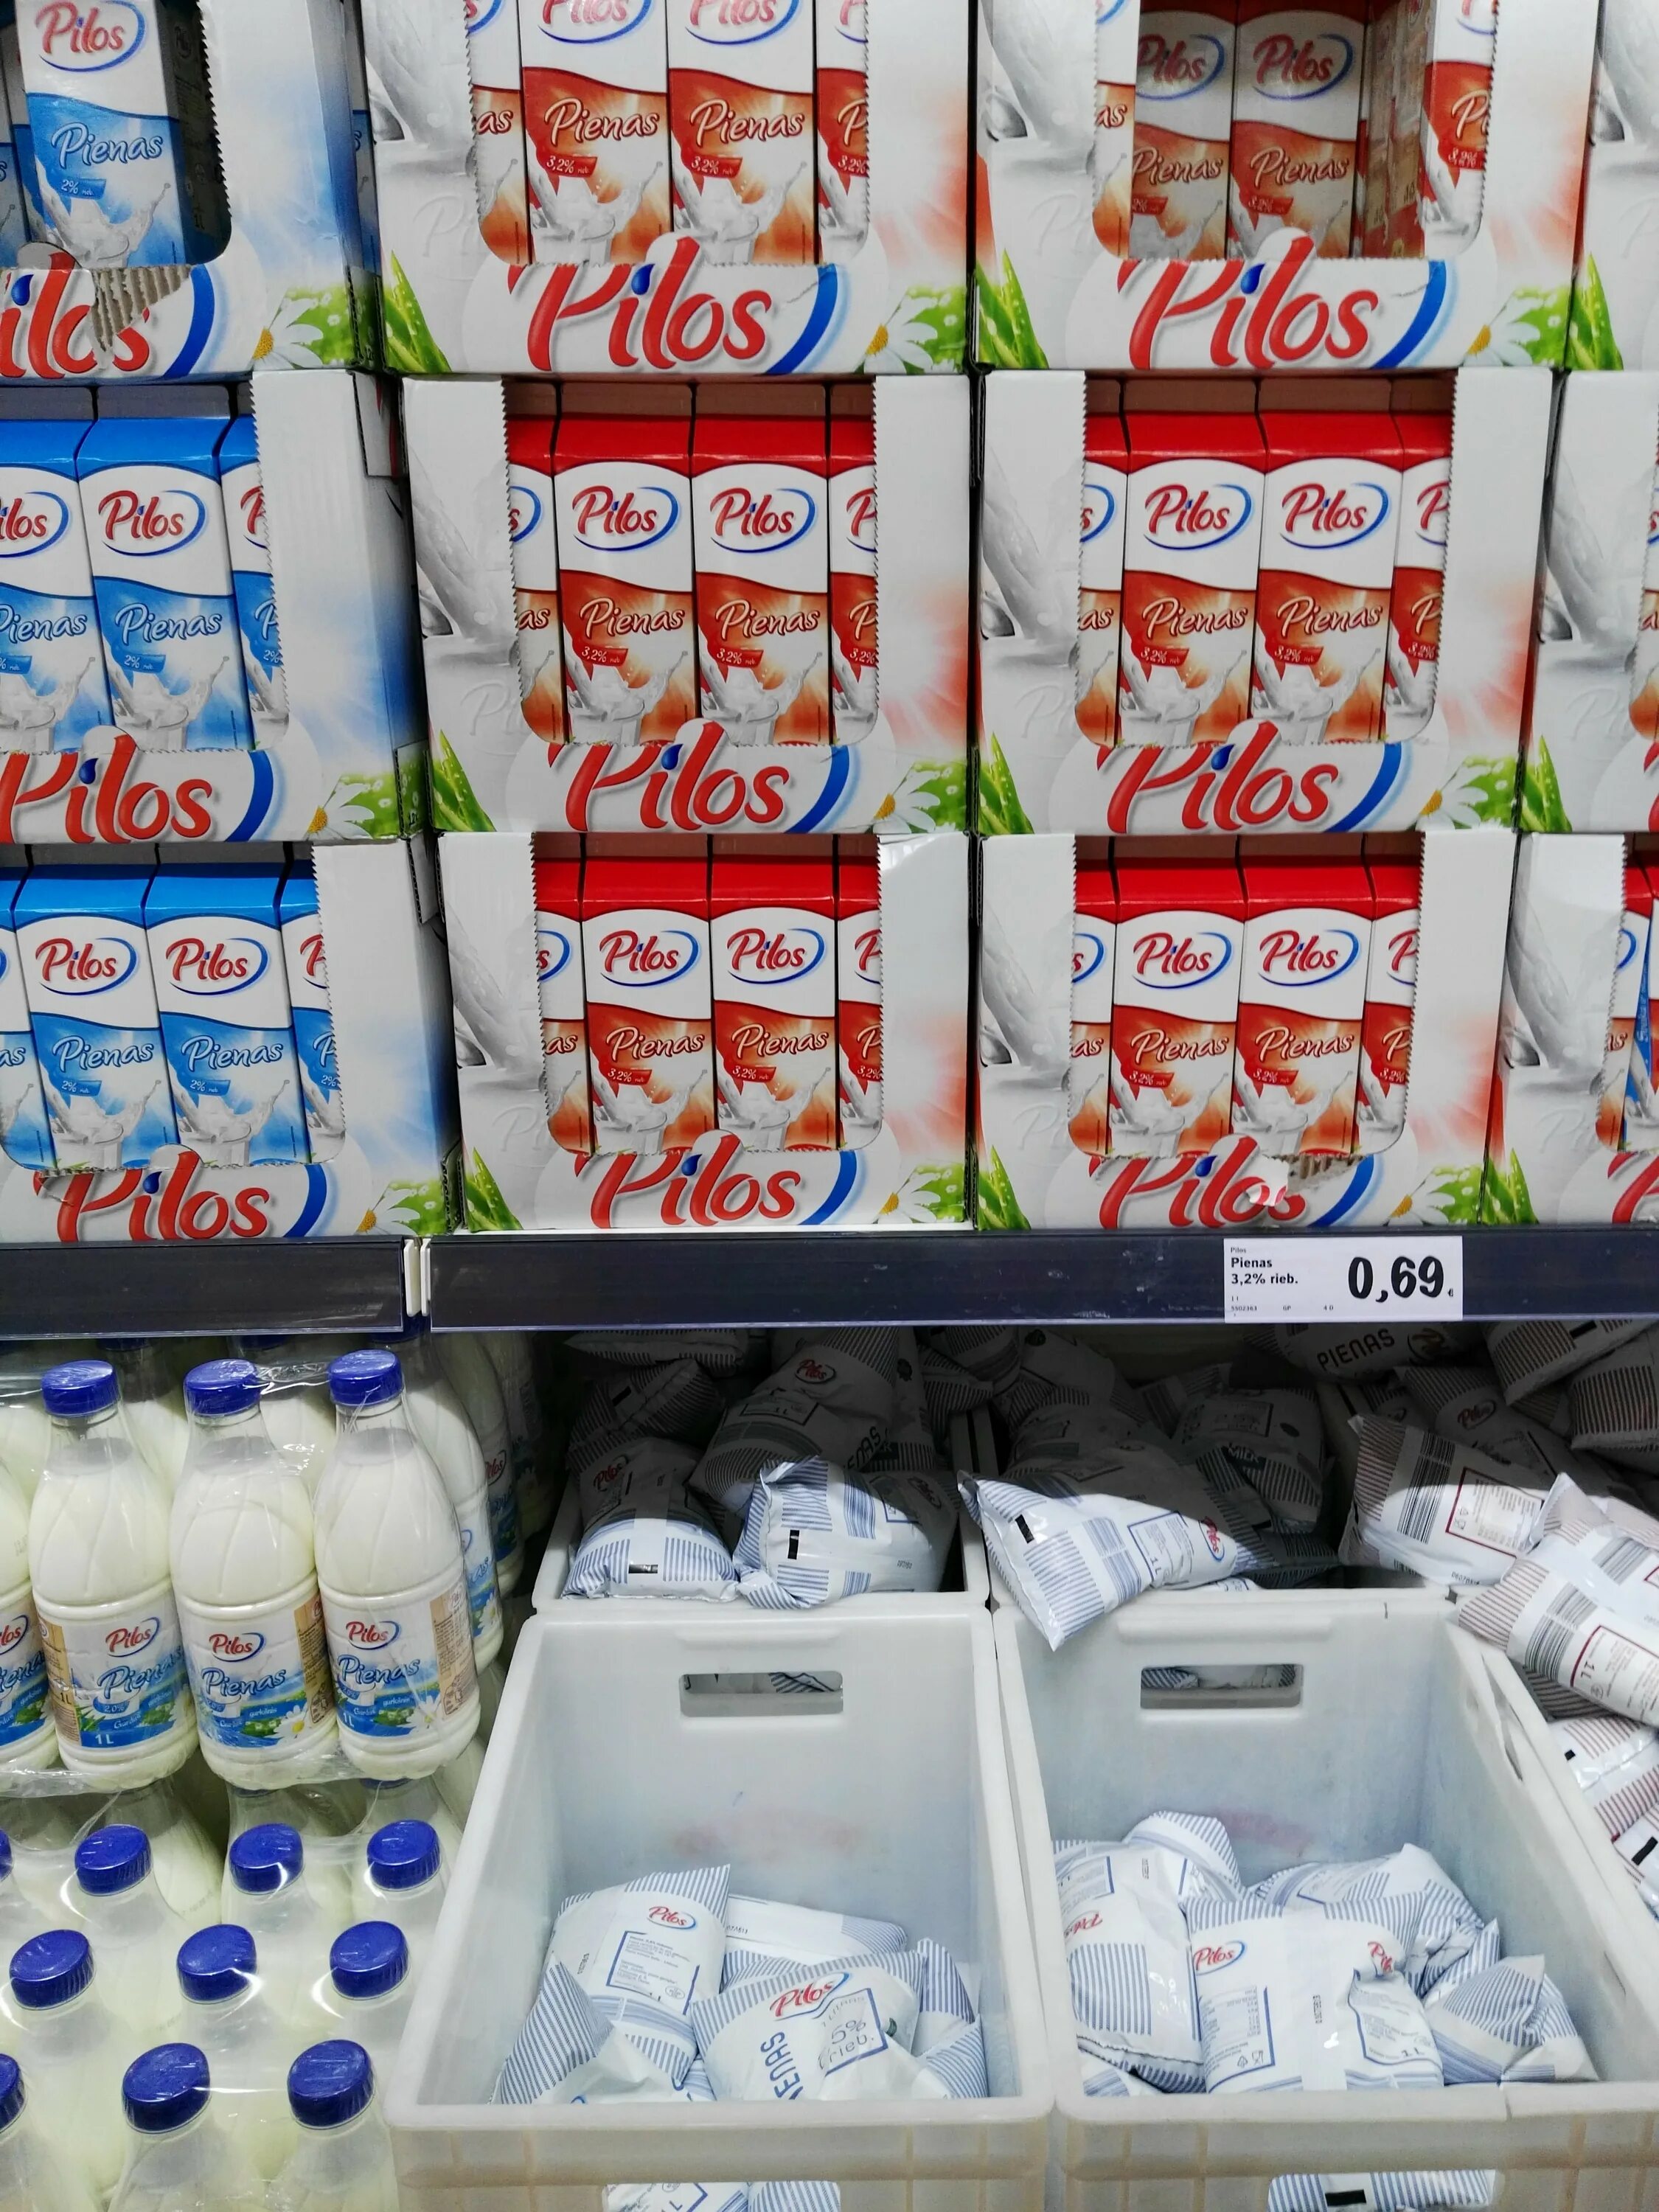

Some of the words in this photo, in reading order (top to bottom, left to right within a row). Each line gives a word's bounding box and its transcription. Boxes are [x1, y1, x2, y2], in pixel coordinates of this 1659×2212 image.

[35, 2, 126, 55] Pilos
[1137, 33, 1204, 83] Pilos
[1253, 33, 1333, 84] Pilos
[543, 97, 660, 146] Pienas
[689, 97, 805, 147] Pienas
[51, 122, 166, 170] Pienas
[546, 155, 574, 173] 3,2%
[691, 156, 719, 174] 3,2%
[838, 155, 866, 174] 3,2%
[1132, 147, 1223, 187] Pienas
[60, 179, 79, 194] 2%
[1250, 147, 1349, 188] Pienas
[0, 251, 150, 379] ilos
[508, 236, 772, 372] Pilos
[1117, 235, 1378, 369] Pilos
[0, 498, 47, 540] los
[98, 490, 184, 541] Pilos
[571, 485, 657, 536] Pilos
[710, 487, 795, 537] Pilos
[1144, 484, 1231, 534] Pilos
[1281, 482, 1368, 533] Pilos
[114, 603, 222, 645] Pienas
[580, 597, 686, 641] Pienas
[715, 599, 821, 642] Pienas
[1141, 596, 1248, 639] Pienas
[1276, 594, 1384, 638] Pienas
[124, 654, 140, 668] 2%
[581, 646, 607, 663] 3,2%
[717, 647, 742, 664] 3,2%
[849, 648, 876, 664] 3,2%
[547, 720, 790, 832] Pilos
[1096, 720, 1339, 833] Pilos
[35, 937, 116, 981] Pilos
[166, 937, 248, 981] Pilos
[599, 929, 679, 973] Pilos
[727, 927, 806, 971] Pilos
[1133, 932, 1213, 976] Pilos
[1259, 929, 1339, 973] Pilos
[52, 1034, 153, 1072] Pienas
[181, 1034, 283, 1071] Pienas
[606, 1025, 705, 1062] Pienas
[731, 1023, 830, 1060] Pienas
[1130, 1027, 1230, 1064] Pienas
[1254, 1025, 1354, 1061] Pienas
[61, 1079, 77, 1092] 2%
[189, 1079, 205, 1092] 2%
[321, 1074, 337, 1087] 2%
[608, 1068, 632, 1082] 3,2%
[732, 1065, 757, 1080] 3,2%
[858, 1065, 881, 1079] 3,2%
[32, 1150, 270, 1242] Pilos
[574, 1133, 801, 1229] Pilos
[1231, 1257, 1273, 1268] Pienas
[1231, 1273, 1266, 1286] 3,2%
[1270, 1273, 1298, 1285] rieb.
[1348, 1256, 1444, 1303] 0,69
[1317, 1328, 1396, 1371] PIENAS
[847, 1426, 881, 1470] ENAS
[0, 1624, 21, 1646] los
[105, 1626, 151, 1652] Pilos
[209, 1633, 253, 1655] Pilos
[346, 1621, 389, 1643] Pilos
[0, 1649, 45, 1694] iena
[97, 1645, 183, 1700] Pienas
[201, 1667, 286, 1698] Pienas
[337, 1654, 420, 1685] Pienas
[649, 1906, 687, 1926] Pilos
[1193, 1947, 1236, 1971] Pilos
[770, 1982, 835, 2017] Pilos
